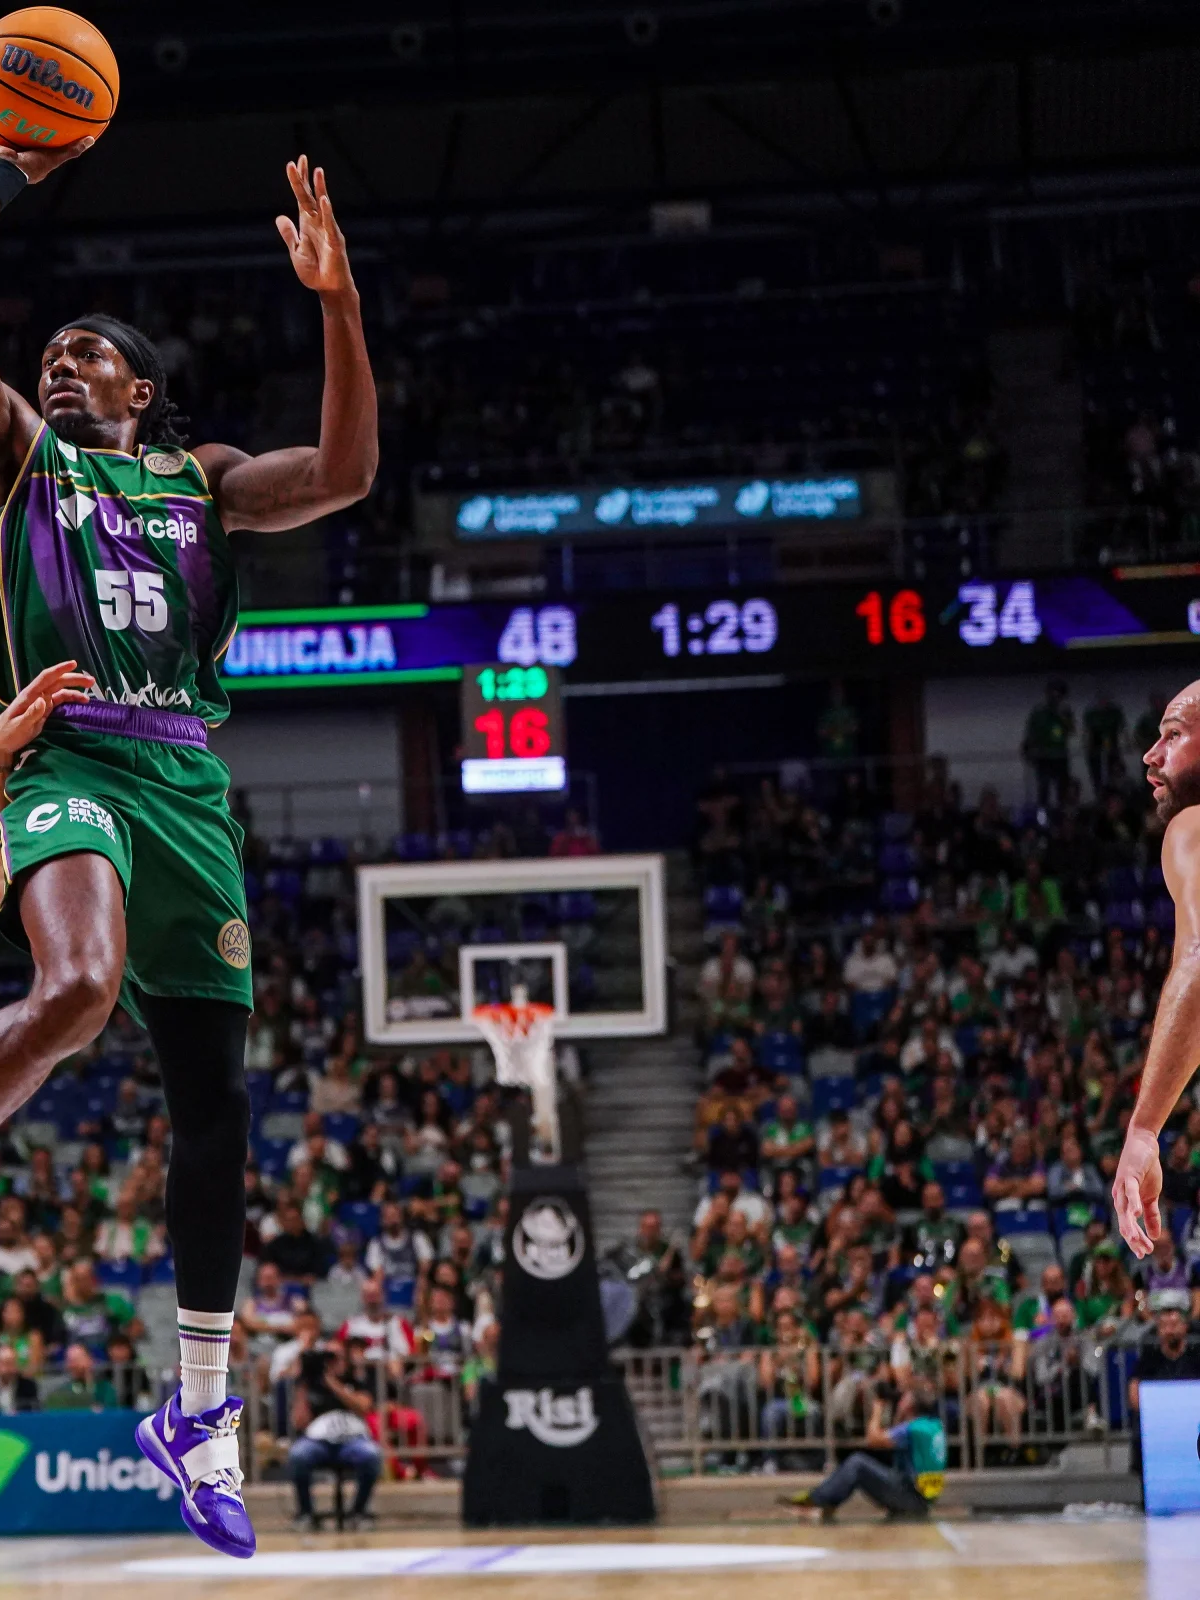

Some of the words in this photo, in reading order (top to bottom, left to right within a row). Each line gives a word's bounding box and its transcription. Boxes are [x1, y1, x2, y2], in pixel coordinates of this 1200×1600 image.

[1, 44, 96, 111] Wilson
[102, 512, 198, 548] Uncaja
[95, 569, 168, 632] 55
[651, 598, 779, 656] 1:29
[856, 589, 926, 645] 16
[958, 580, 1042, 646] 34
[224, 625, 396, 676] UNICAJA
[474, 708, 550, 759] 16
[36, 1449, 182, 1500] Unicaj
